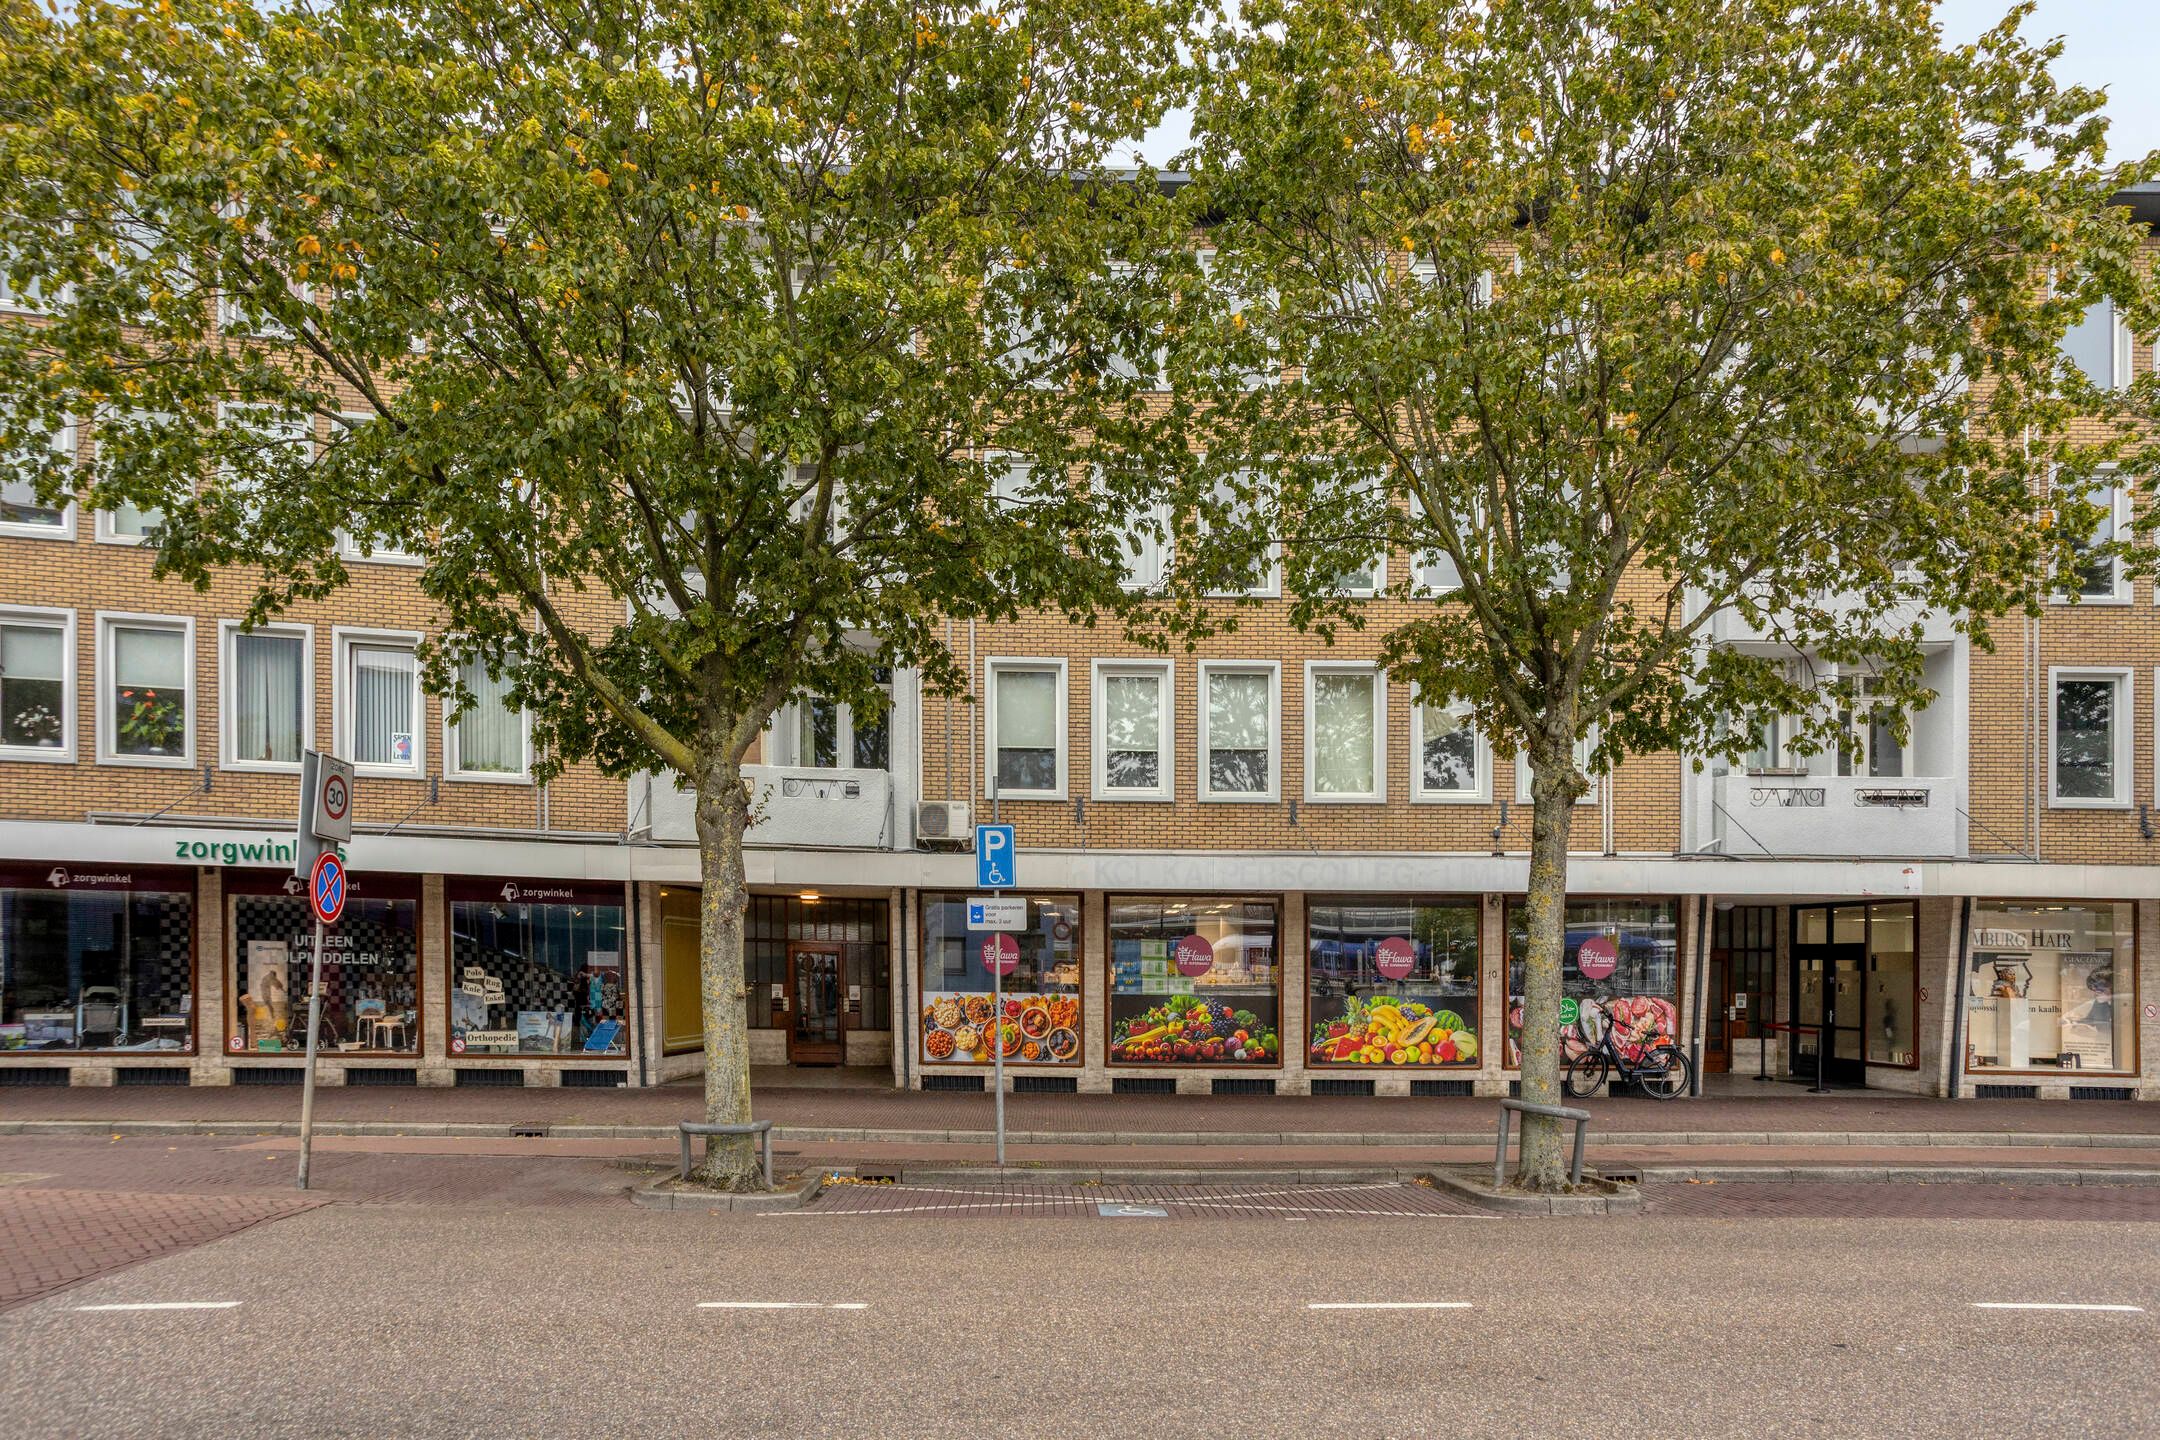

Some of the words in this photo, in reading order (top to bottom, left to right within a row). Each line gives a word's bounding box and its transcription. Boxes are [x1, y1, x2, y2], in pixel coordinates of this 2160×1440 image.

[331, 763, 345, 773] ZONE
[328, 788, 344, 806] 30
[176, 838, 347, 865] zorgwins
[985, 830, 1006, 861] P
[73, 873, 132, 885] zorgwinkel
[523, 888, 574, 899] zorgwinkel
[295, 935, 353, 948] UITEEN
[1187, 950, 1212, 961] Hawa
[1388, 951, 1412, 963] Hawa
[1591, 951, 1615, 964] Hawa
[464, 984, 481, 993] Knie
[485, 994, 504, 1002] Enkel
[467, 1033, 517, 1043] Orthopedie
